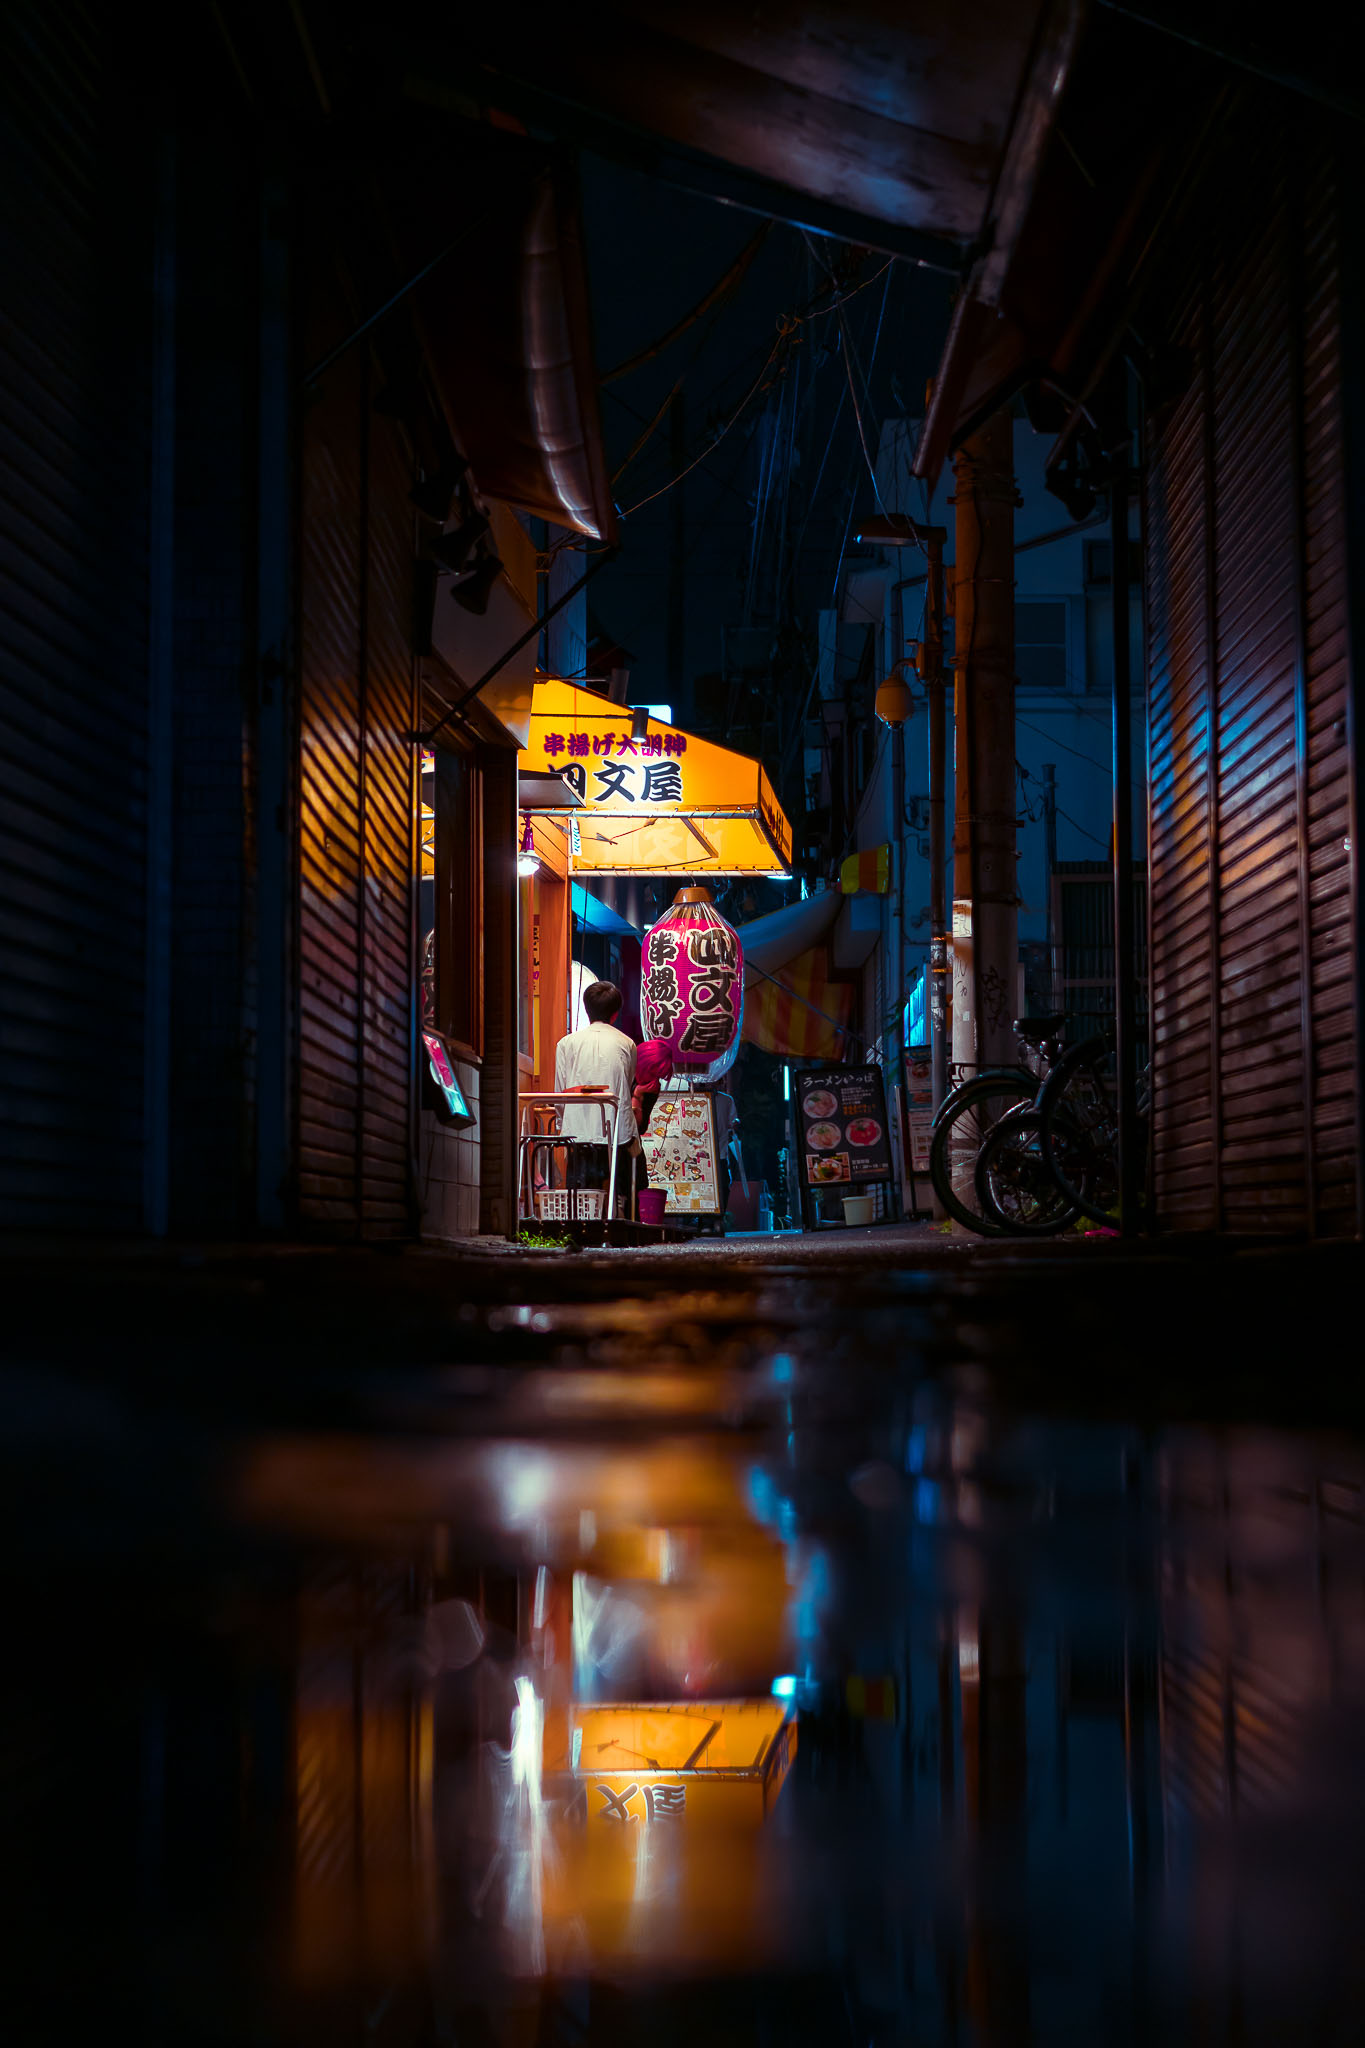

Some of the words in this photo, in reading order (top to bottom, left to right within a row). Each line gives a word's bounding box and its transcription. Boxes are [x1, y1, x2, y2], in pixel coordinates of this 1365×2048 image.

[543, 732, 687, 757] 串揚げ大明神
[647, 929, 685, 1040] 串揚げ
[679, 928, 737, 1054] 四文屋
